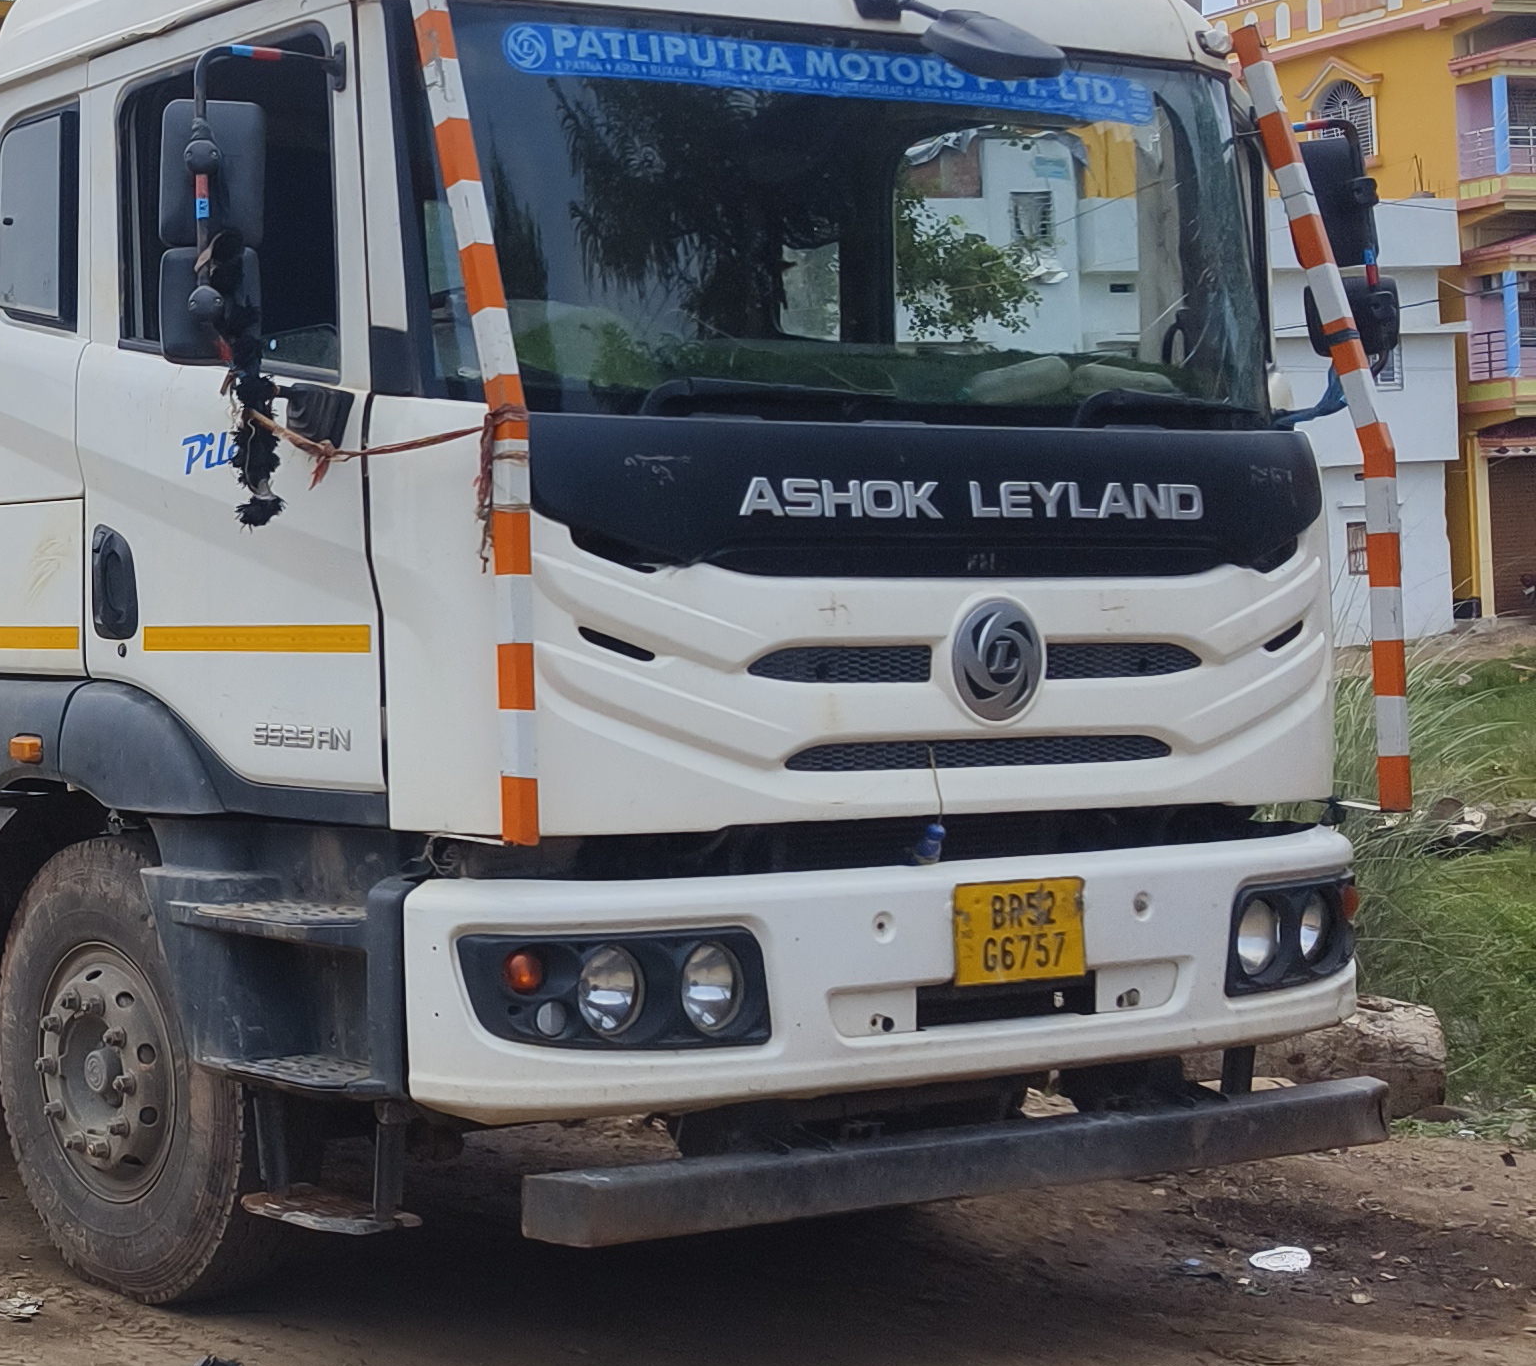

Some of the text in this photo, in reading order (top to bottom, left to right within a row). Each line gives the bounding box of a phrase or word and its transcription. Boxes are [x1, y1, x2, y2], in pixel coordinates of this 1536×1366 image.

[551, 28, 794, 75] PATLIPUTRA
[805, 49, 965, 89] MOTORS
[1058, 74, 1125, 107] LTD.
[739, 477, 1204, 520] ASHOK LEYLAND
[253, 722, 314, 749] 5525
[991, 890, 1056, 930] BR52
[983, 931, 1067, 972] G6757
